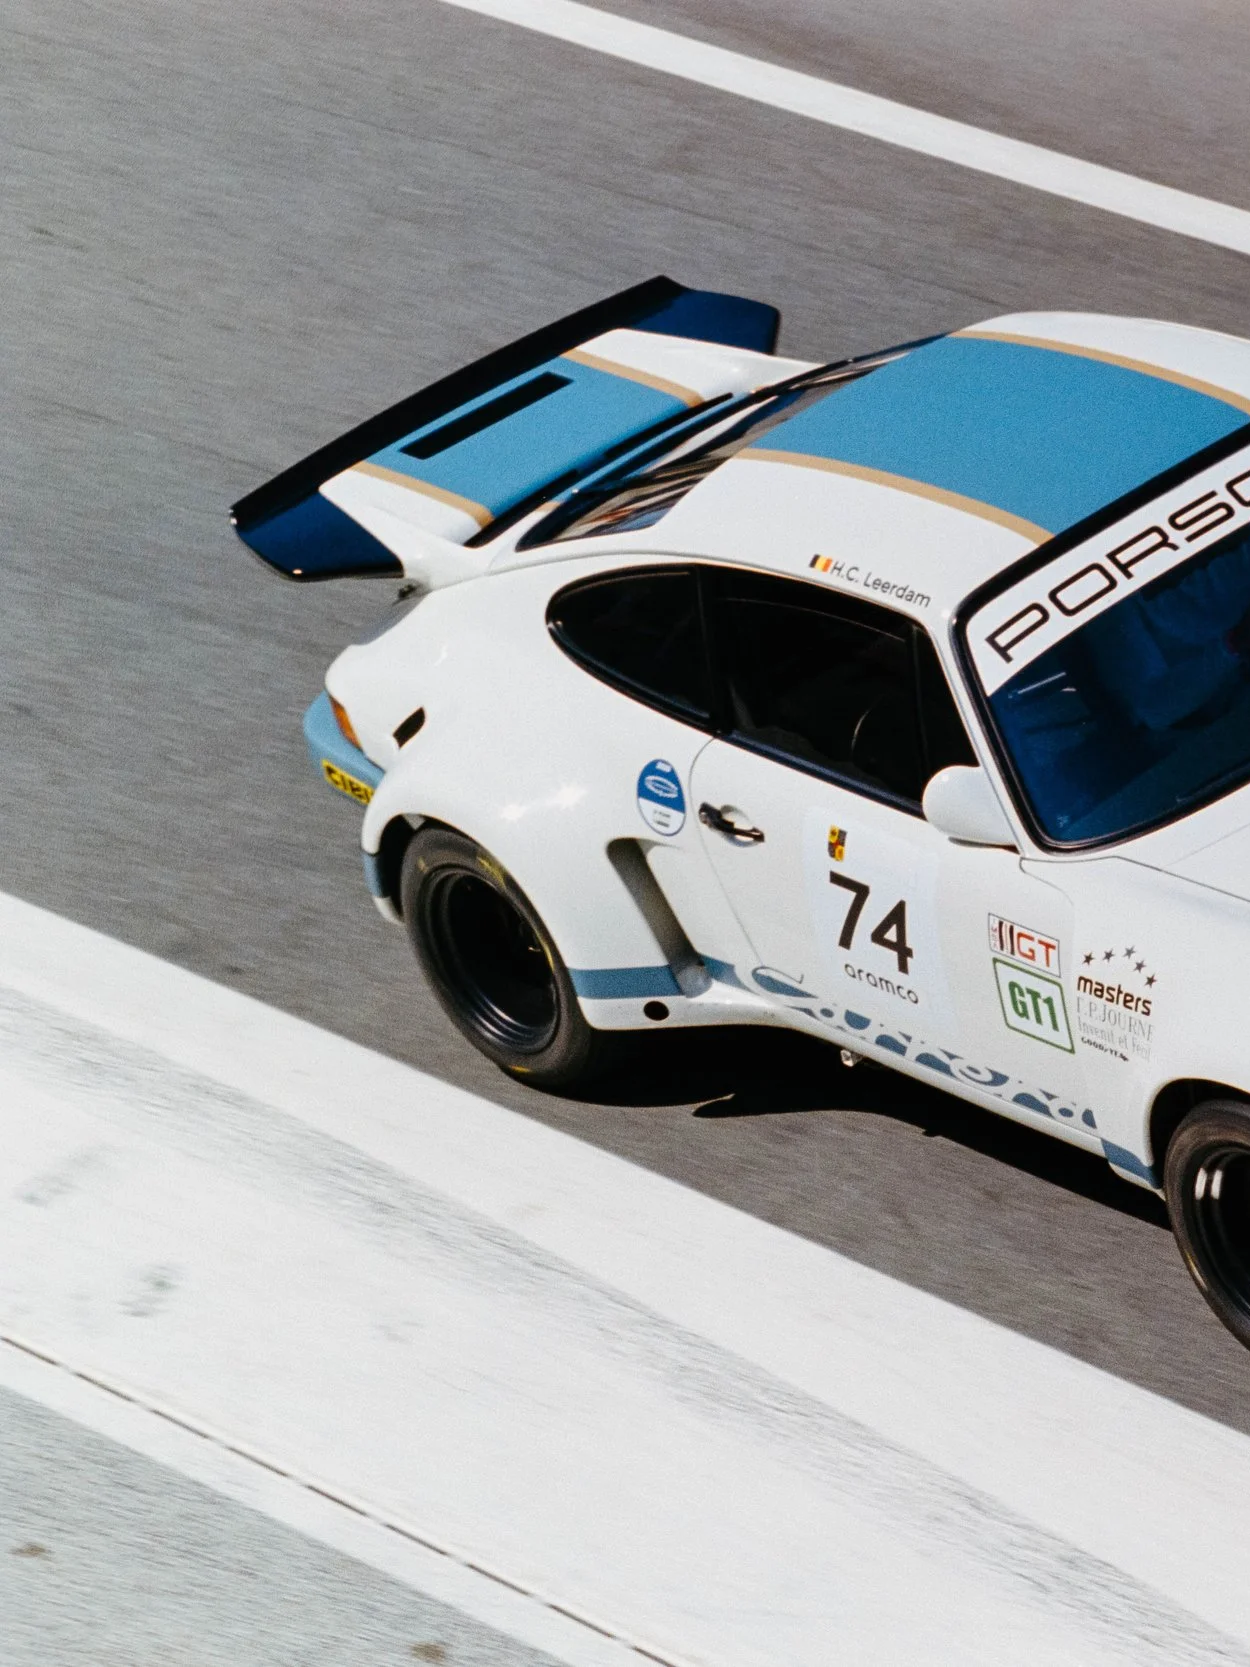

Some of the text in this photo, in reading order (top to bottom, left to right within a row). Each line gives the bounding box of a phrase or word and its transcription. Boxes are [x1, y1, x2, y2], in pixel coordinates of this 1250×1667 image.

[831, 560, 932, 608] H.C. Leerdam
[829, 870, 914, 976] 74
[1016, 931, 1056, 968] GT
[844, 962, 919, 1005] aramco
[1008, 980, 1060, 1032] GT1
[1077, 975, 1152, 1017] masters
